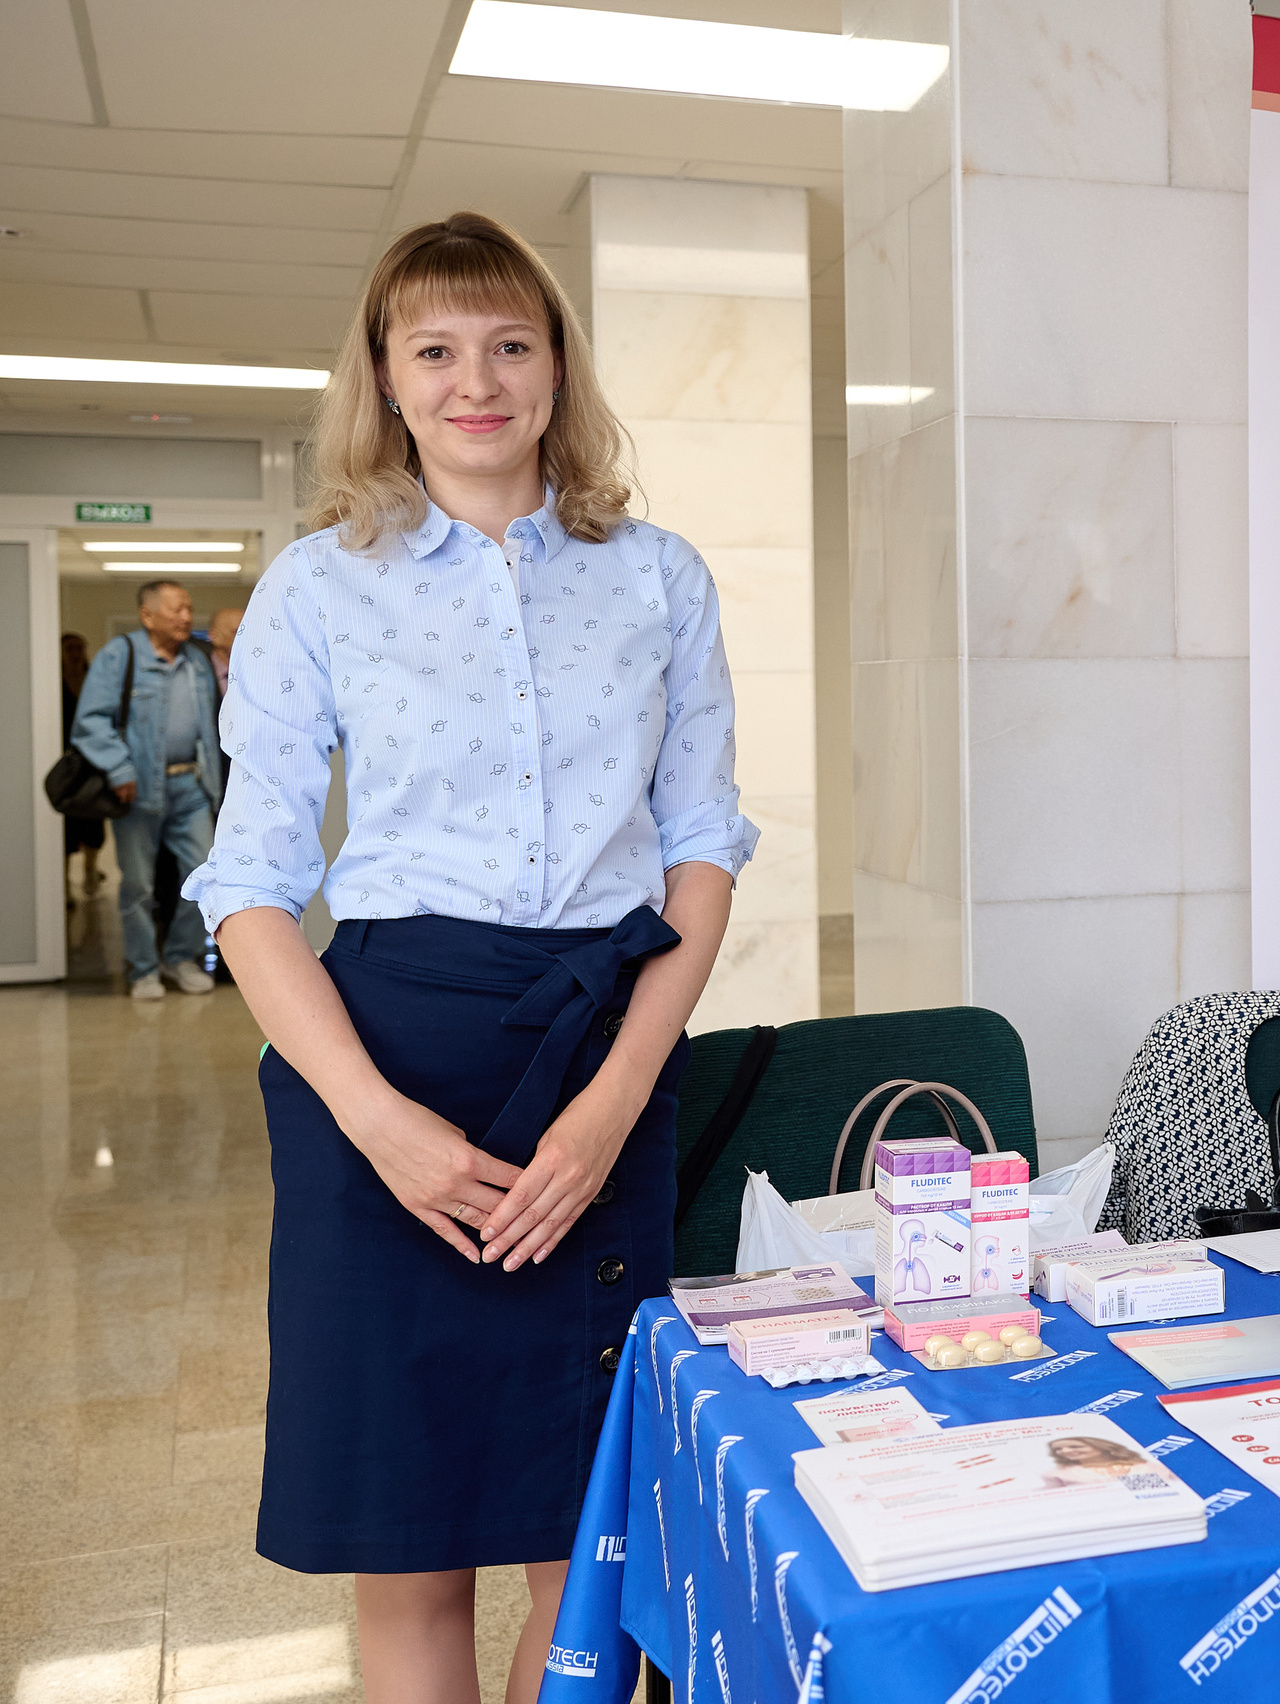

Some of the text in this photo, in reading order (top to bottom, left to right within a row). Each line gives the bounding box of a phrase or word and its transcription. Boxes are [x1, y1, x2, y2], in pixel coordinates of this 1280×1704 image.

[911, 1177, 952, 1187] FLUDITEC
[982, 1188, 1018, 1198] FLUDITEC
[907, 1298, 1013, 1314] ПОЛИЖИНАКС
[752, 1315, 842, 1330] PHARMATEX
[818, 1400, 900, 1415] ПОЧУВСТВУЙ
[836, 1407, 890, 1417] ЛЮБОВЬ
[548, 1644, 599, 1668] OTECH
